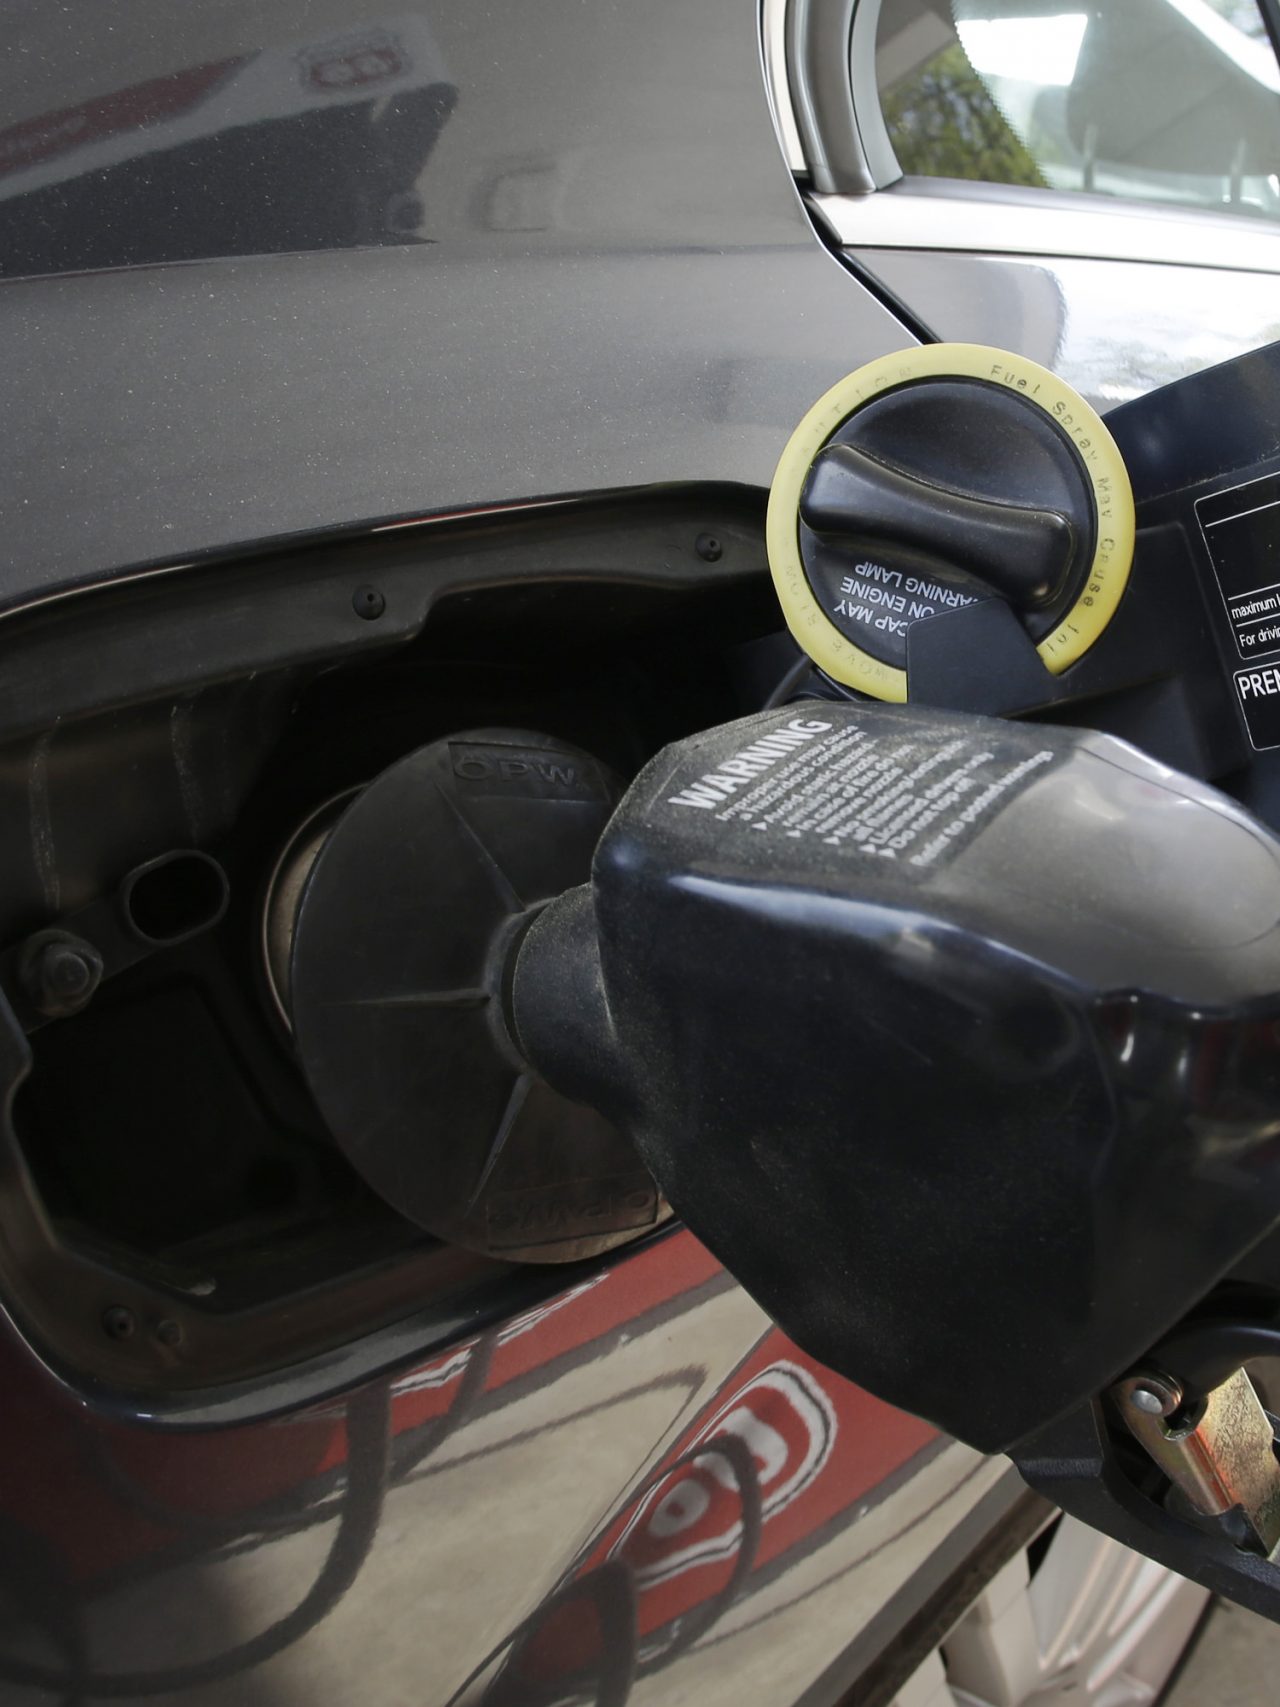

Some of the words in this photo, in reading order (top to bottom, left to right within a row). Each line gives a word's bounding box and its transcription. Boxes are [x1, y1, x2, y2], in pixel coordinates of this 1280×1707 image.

[990, 364, 1041, 394] Fuel
[1052, 401, 1098, 461] Spray
[1096, 477, 1113, 518] May
[840, 576, 907, 613] ENGINE
[855, 561, 902, 588] LAMP
[905, 577, 979, 607] ARNING
[1082, 537, 1115, 607] Cause
[834, 599, 874, 624] MAY
[1231, 596, 1277, 619] maximum
[1239, 633, 1256, 647] For
[454, 758, 574, 787] OPW
[668, 718, 833, 810] WARNING
[715, 777, 779, 822] Improper
[776, 761, 801, 779] use
[798, 744, 826, 762] may
[823, 725, 859, 746] cause
[739, 812, 753, 821] a
[747, 766, 815, 814] hazardous
[811, 731, 868, 767] condition
[795, 819, 818, 831] In
[814, 797, 846, 820] case
[842, 785, 859, 798] of
[851, 770, 879, 787] fire
[875, 758, 895, 771] do
[891, 744, 916, 759] not
[763, 794, 805, 824] Avoid
[801, 769, 839, 795] static
[782, 792, 831, 827] remain
[826, 781, 845, 795] at
[839, 754, 879, 782] nozzle
[814, 796, 868, 834] remove
[862, 766, 904, 799] nozzle
[943, 820, 965, 836] to
[959, 784, 1006, 822] posted
[832, 820, 860, 838] No
[868, 797, 930, 845] Licensed
[887, 829, 916, 849] Do
[910, 809, 940, 831] not
[929, 791, 960, 811] top
